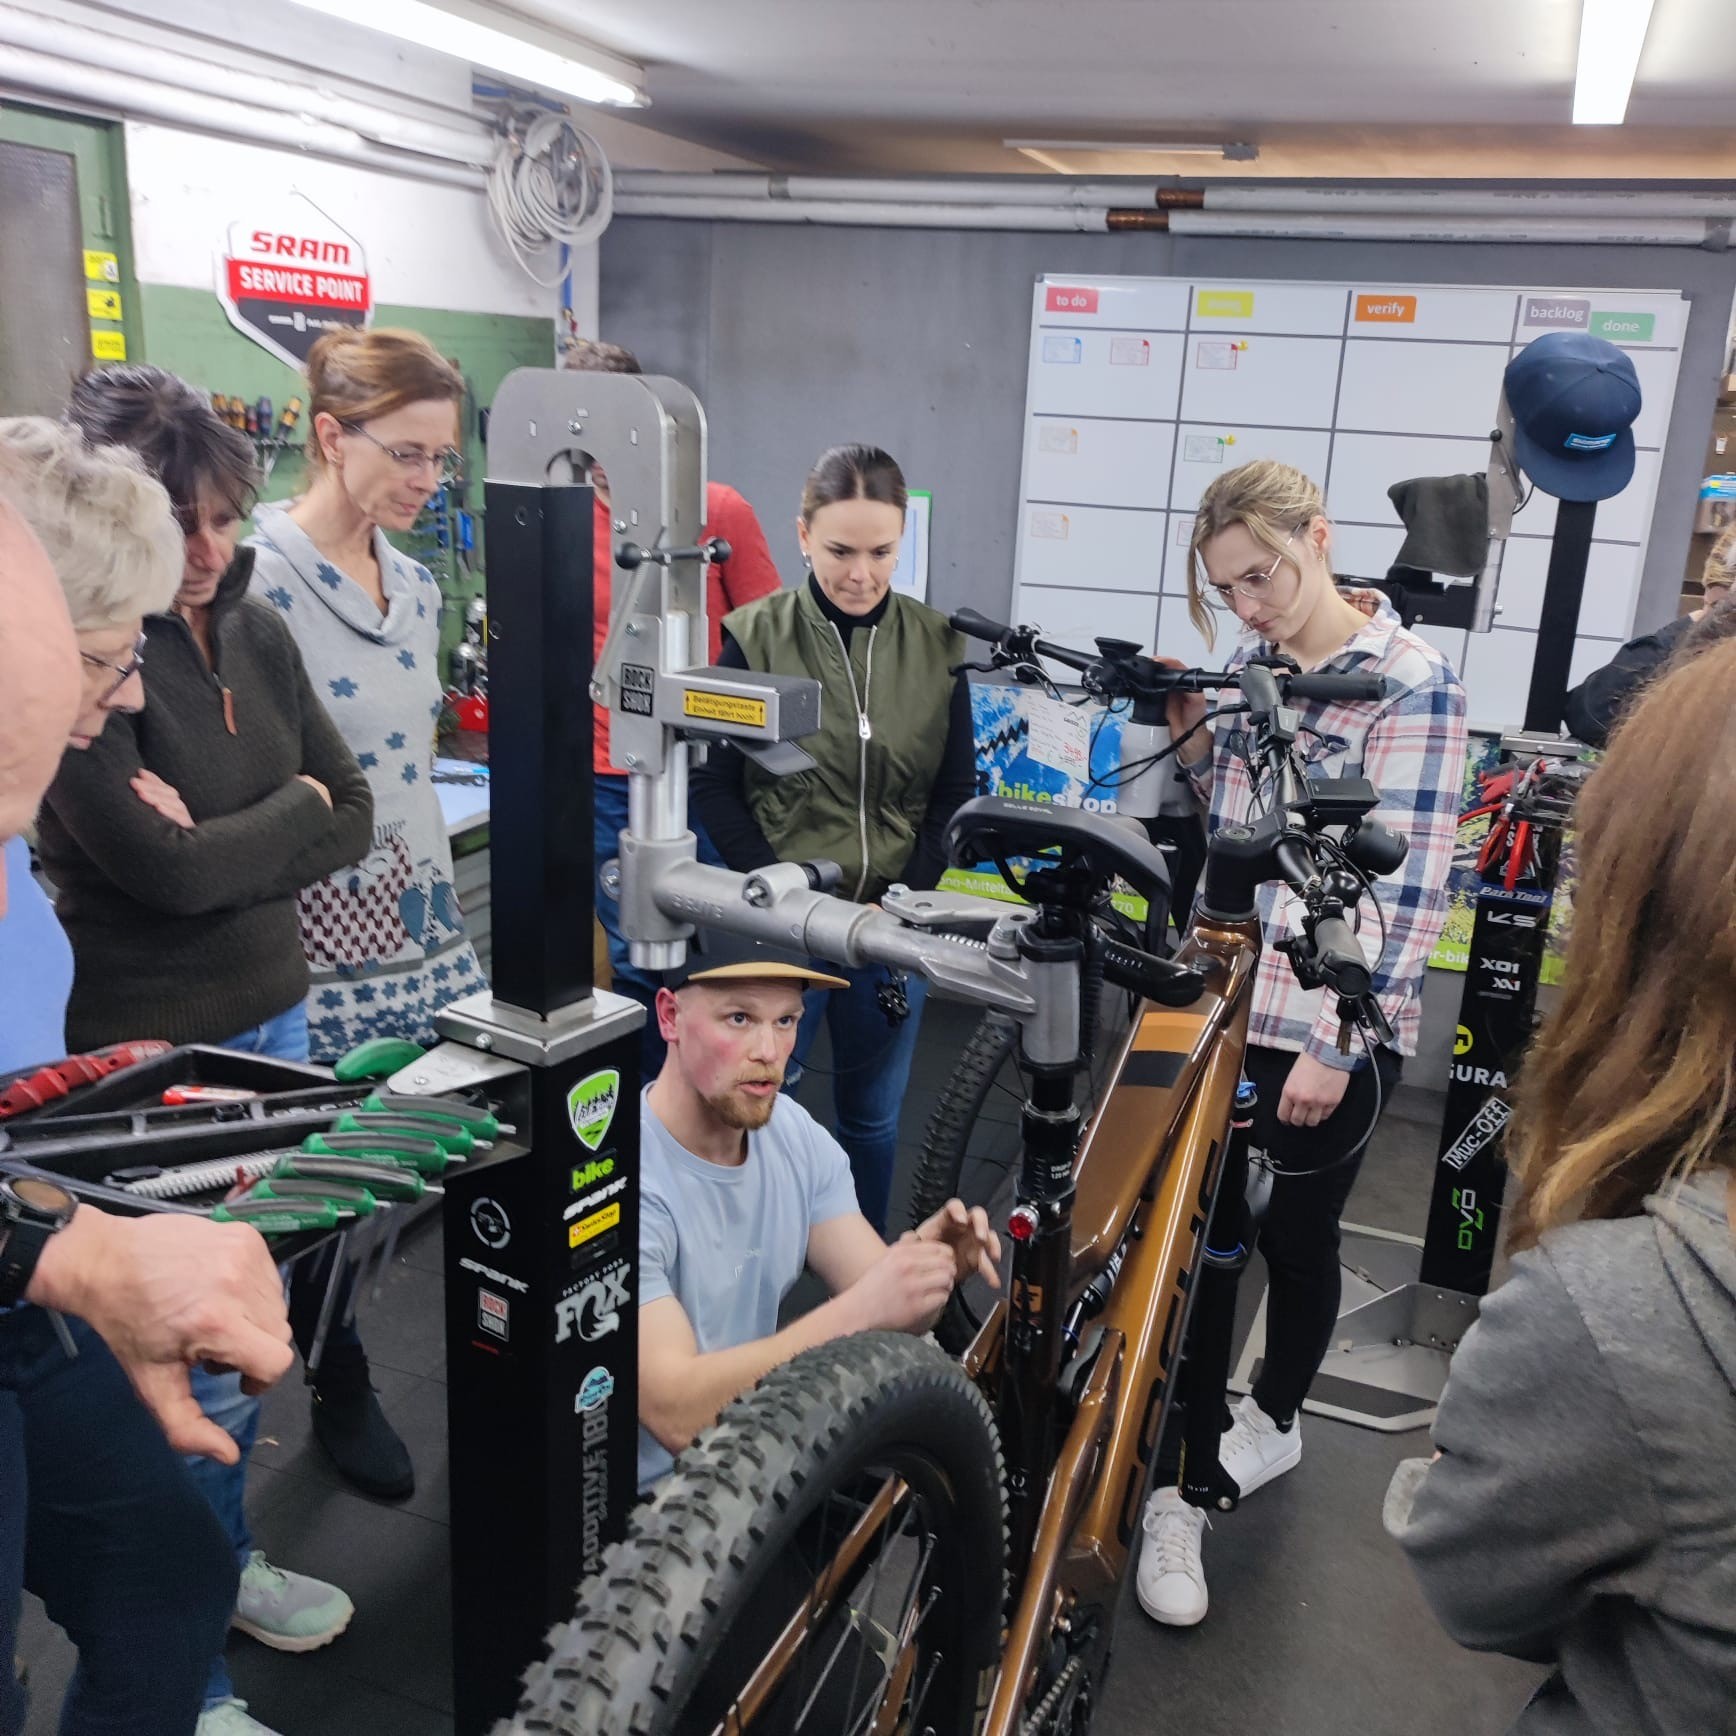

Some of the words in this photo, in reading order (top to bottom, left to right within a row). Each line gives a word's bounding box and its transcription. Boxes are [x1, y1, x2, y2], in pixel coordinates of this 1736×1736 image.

[250, 231, 350, 264] SRAM
[239, 265, 314, 297] SERVICE
[315, 275, 364, 303] POINT
[1056, 295, 1069, 307] to
[1070, 295, 1087, 308] do
[1367, 302, 1405, 317] verify
[1530, 305, 1585, 323] backlog
[1603, 319, 1640, 333] done
[624, 668, 651, 688] ROCK
[998, 780, 1118, 814] bikeshop
[1487, 910, 1537, 928] KS
[572, 1158, 615, 1191] bike
[555, 1262, 631, 1344] FOX
